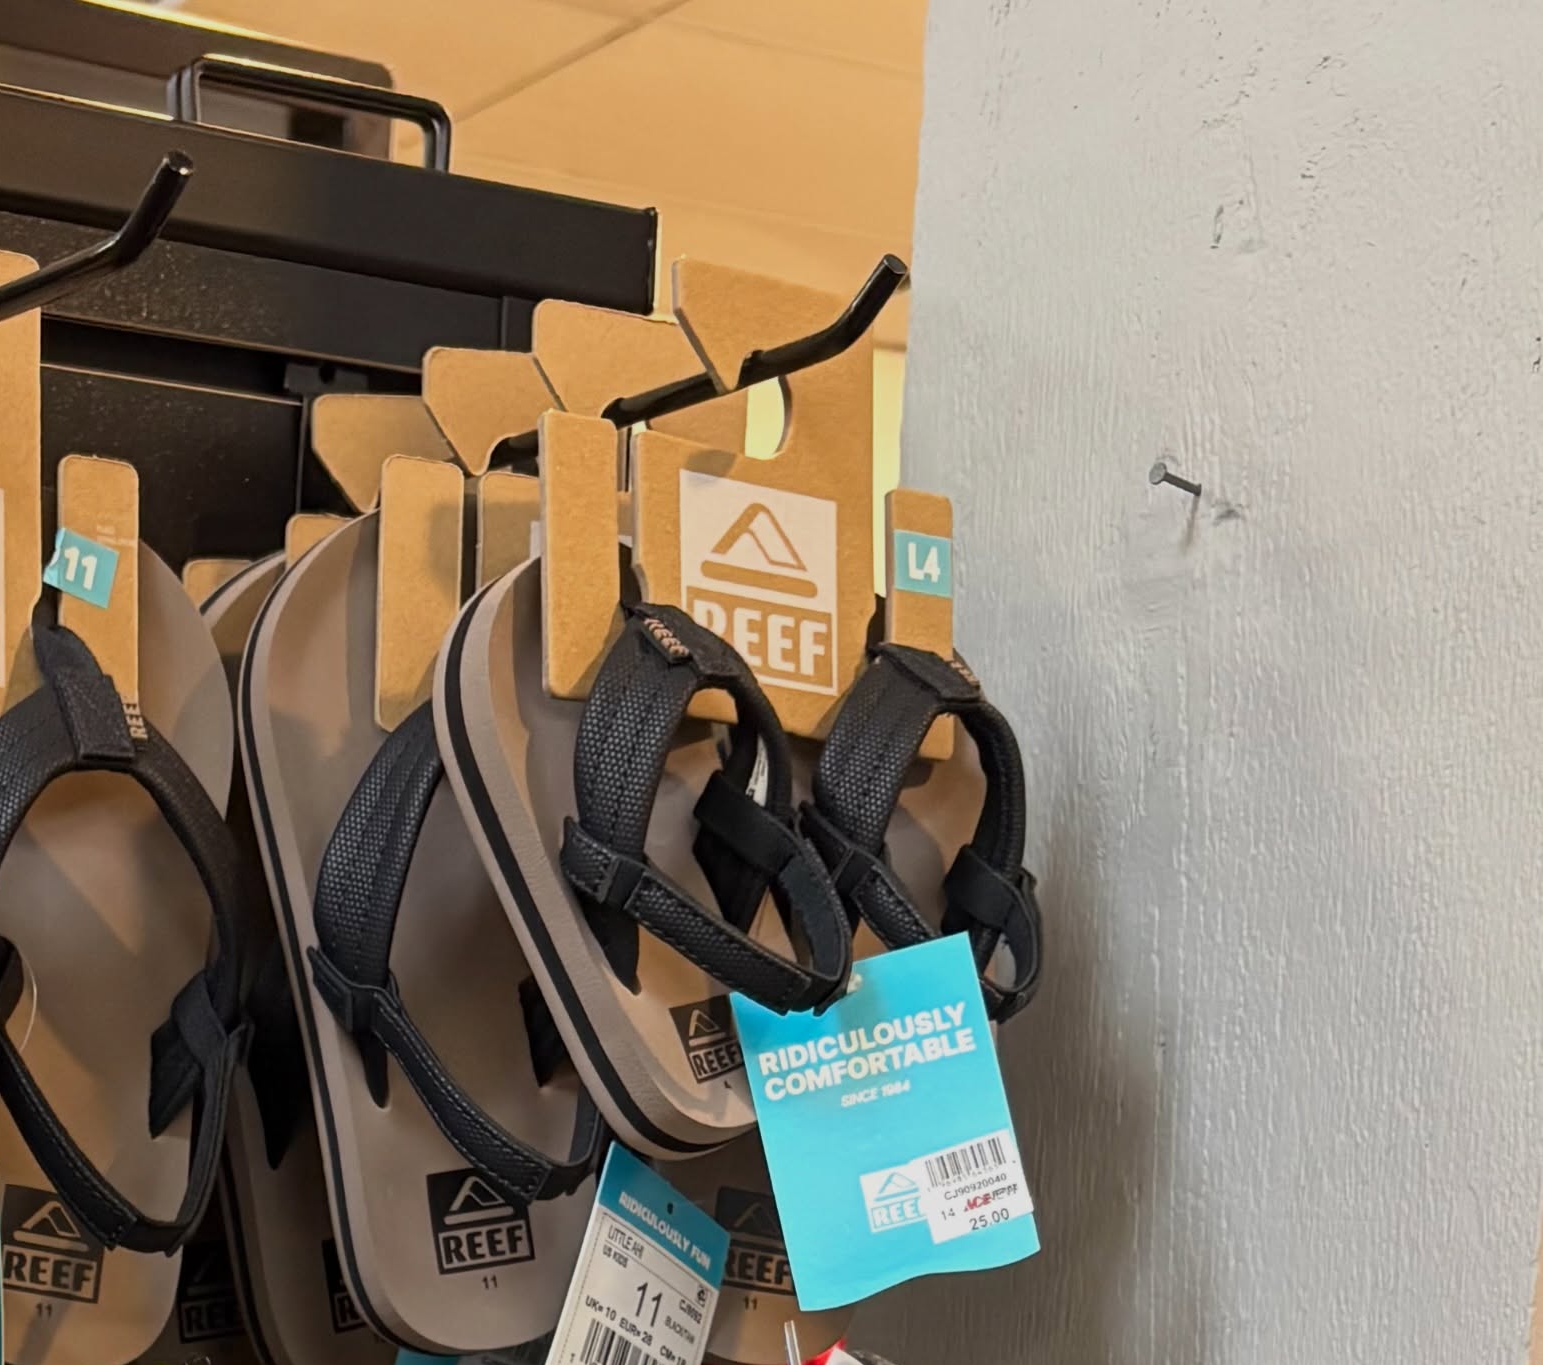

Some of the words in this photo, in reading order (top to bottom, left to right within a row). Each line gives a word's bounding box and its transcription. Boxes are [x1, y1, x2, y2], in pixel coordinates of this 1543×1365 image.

[64, 546, 99, 592] 11
[758, 1002, 966, 1078] RIDICULOUSLY
[691, 1044, 738, 1078] REEF
[764, 1029, 977, 1102] COMFORTABLE
[618, 1191, 691, 1252] RIDICULOUSLY
[690, 1244, 712, 1271] FUN
[872, 1198, 926, 1228] REE
[969, 1207, 1010, 1232] 25.00
[443, 1225, 524, 1266] REEF
[3, 1250, 94, 1292] REEF
[480, 1274, 499, 1290] 11
[35, 1302, 54, 1317] 11
[604, 1306, 618, 1321] 10
[635, 1281, 664, 1329] 11
[743, 1294, 758, 1311] 11
